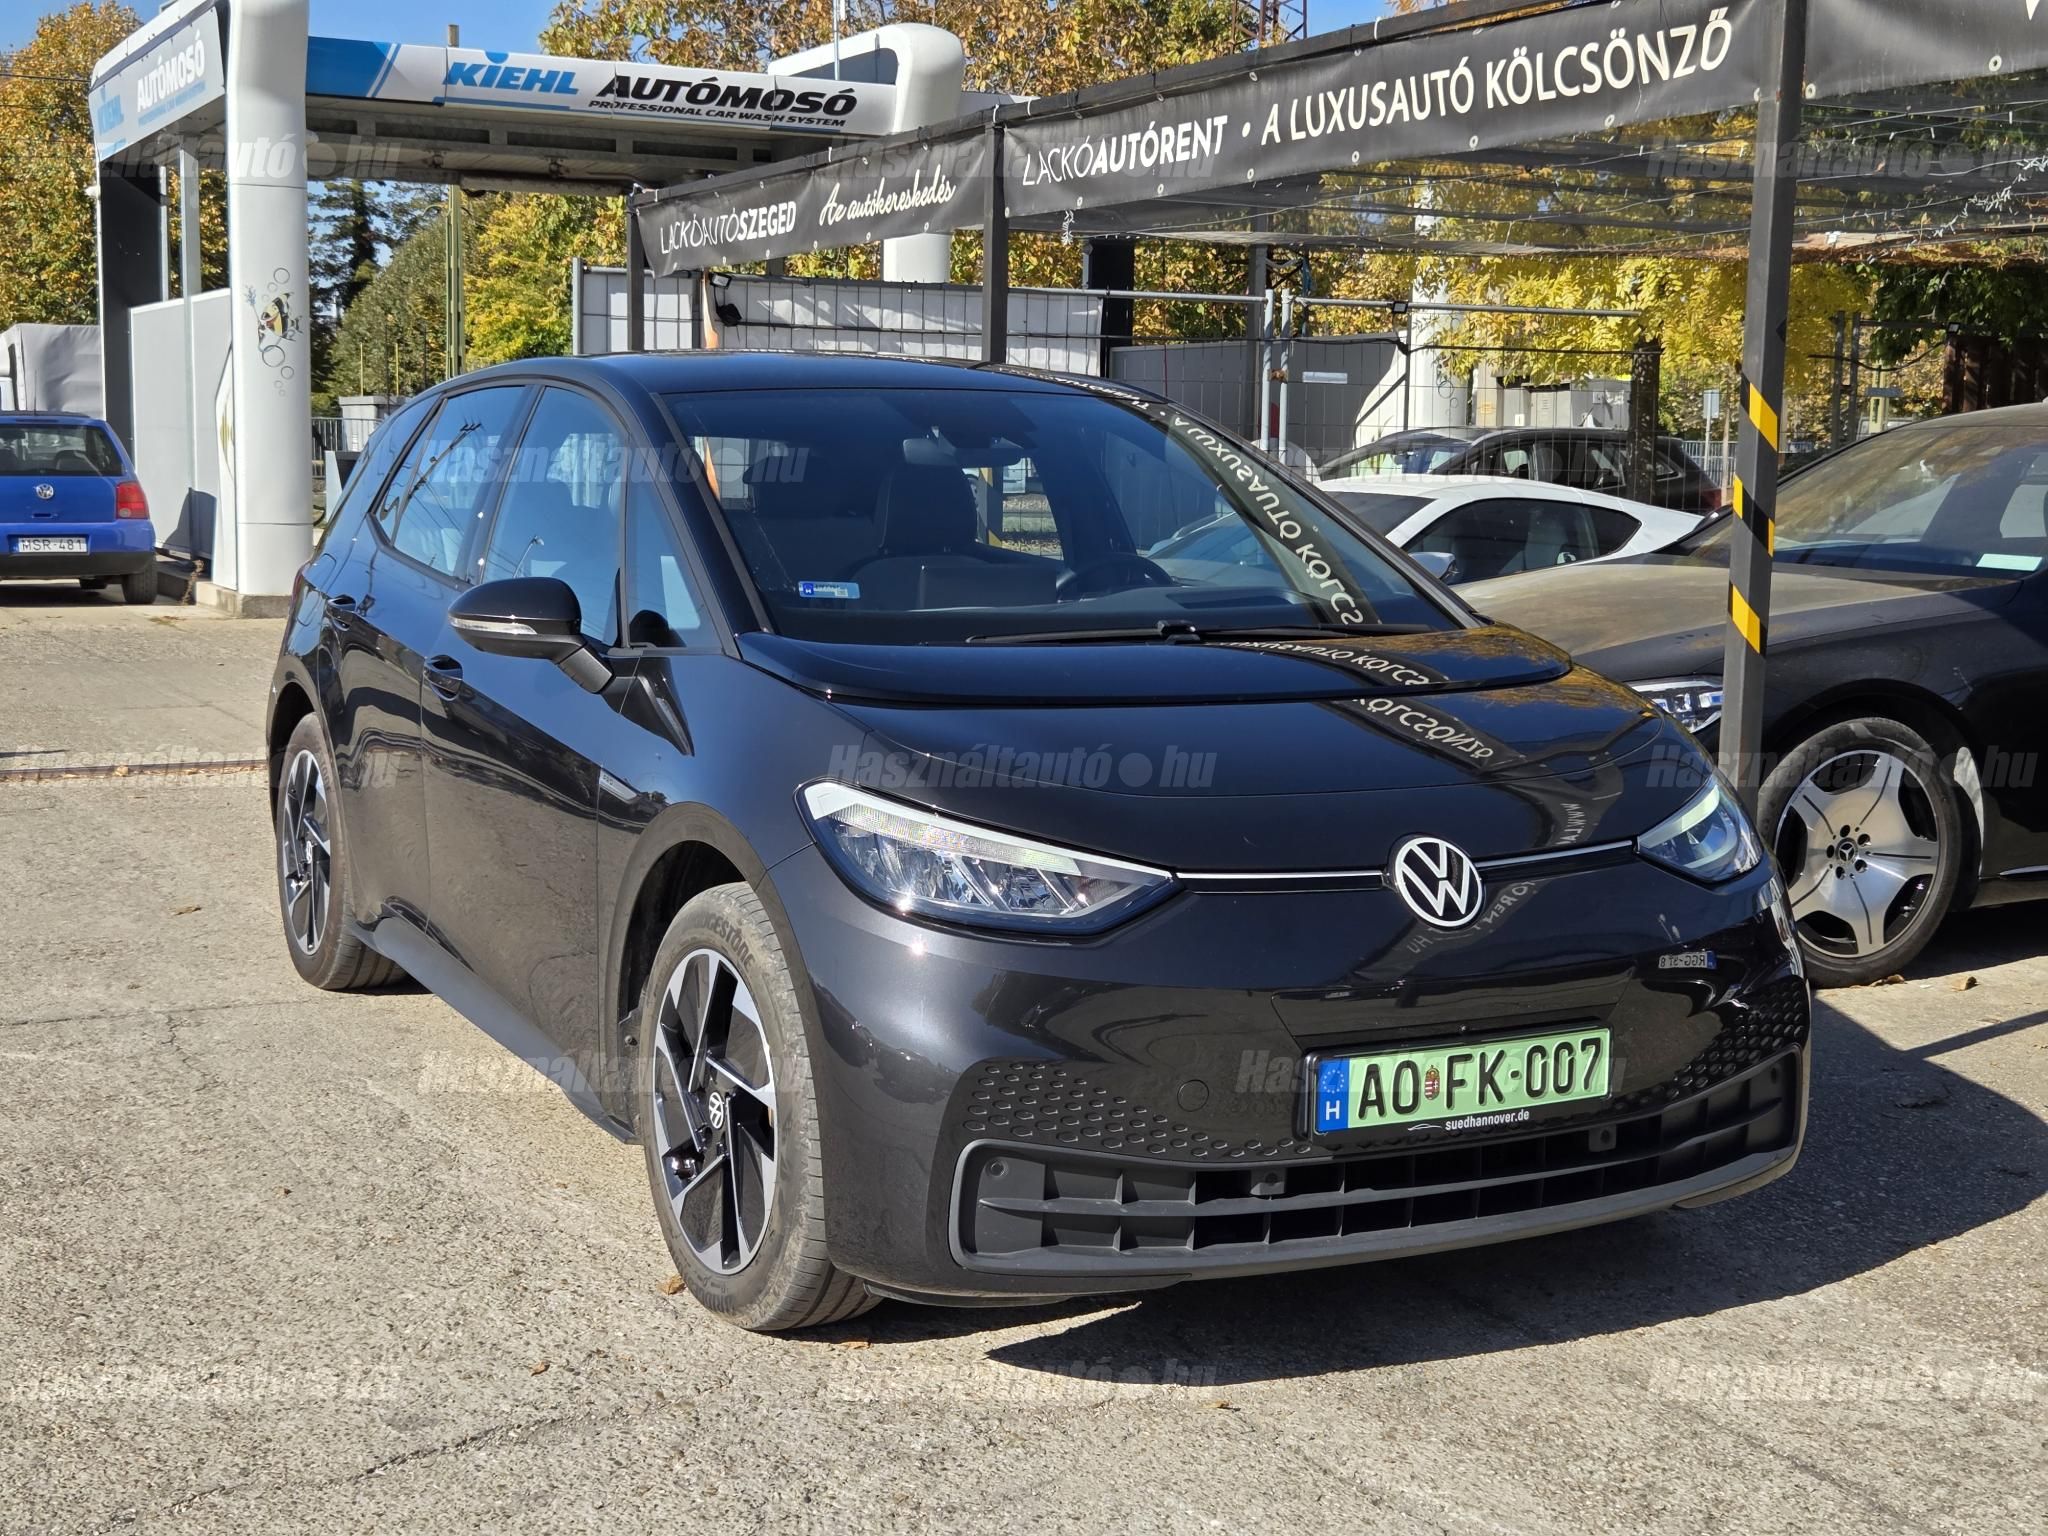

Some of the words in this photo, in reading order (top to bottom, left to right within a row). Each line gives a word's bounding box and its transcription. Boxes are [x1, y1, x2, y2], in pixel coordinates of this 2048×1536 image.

[137, 30, 205, 112] AUTÓMOSÓ
[442, 52, 579, 95] KIEHL
[1261, 103, 1281, 145] A
[1289, 57, 1474, 141] LUXUSAUTÓ
[1486, 6, 1732, 109] KÖLCSÖNZŐ
[588, 100, 702, 116] PROFESSIONAL
[705, 109, 738, 119] CAR
[738, 112, 786, 123] WASH
[786, 115, 846, 127] SYSTEM
[596, 75, 858, 116] AUTÓMOSÓ
[1022, 115, 1228, 186] LACKÓAUTÓRENT
[846, 164, 956, 219] autókereskedés
[660, 201, 797, 254] LACKÓAUTÓSZEGED
[22, 538, 83, 550] MSR-481
[1396, 837, 1482, 927] VW
[1325, 1101, 1340, 1121] H
[1445, 1109, 1530, 1132] suedhannover.de
